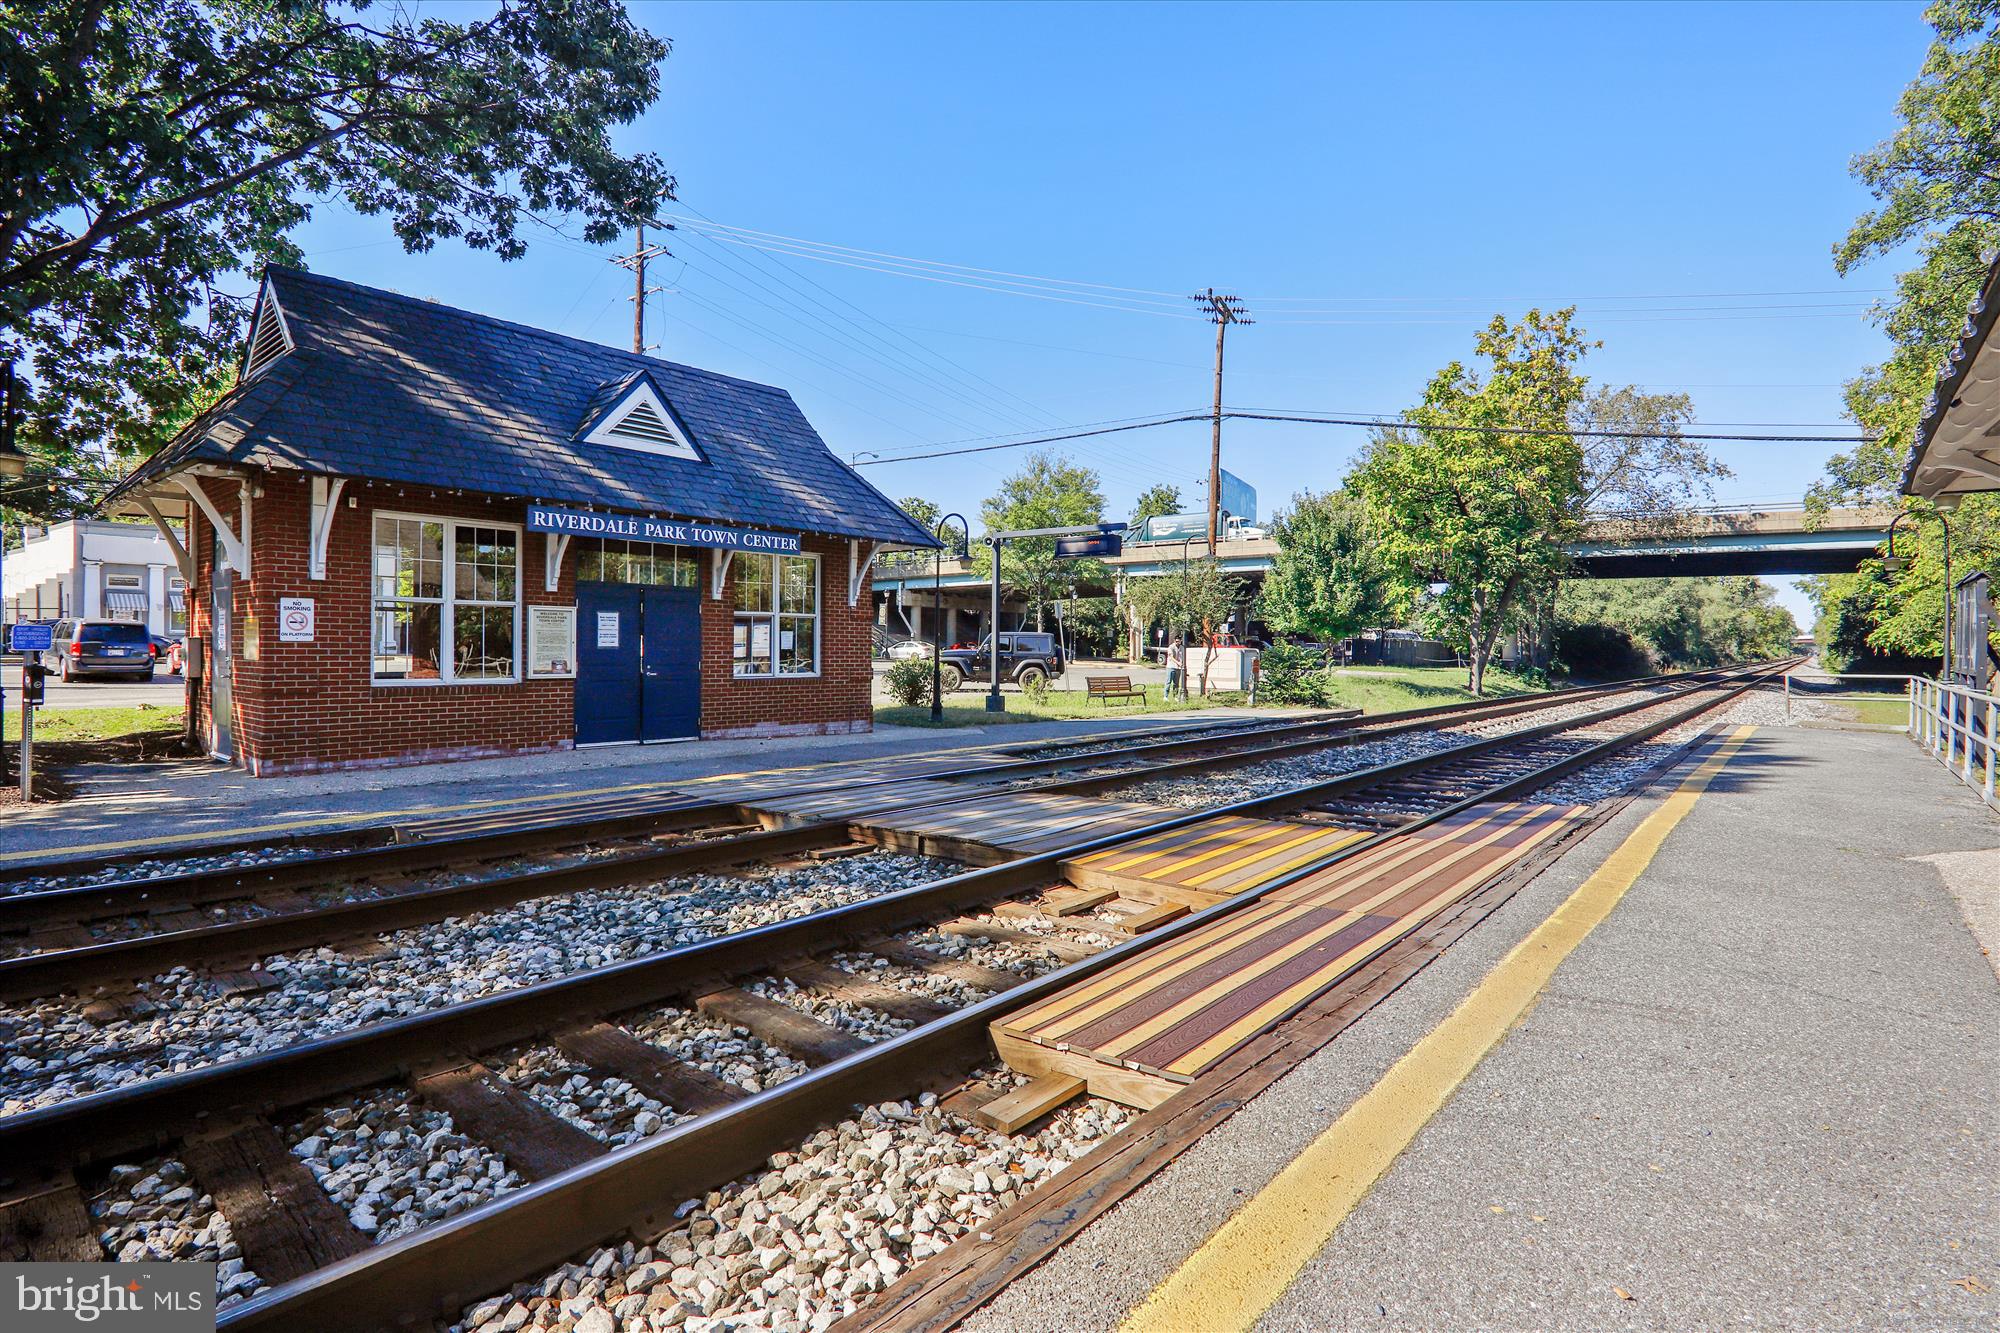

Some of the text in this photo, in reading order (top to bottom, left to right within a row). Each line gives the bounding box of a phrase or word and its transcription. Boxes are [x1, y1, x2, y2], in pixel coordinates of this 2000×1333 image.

[533, 511, 798, 551] RIVERDALE PARK TOWN CENTER
